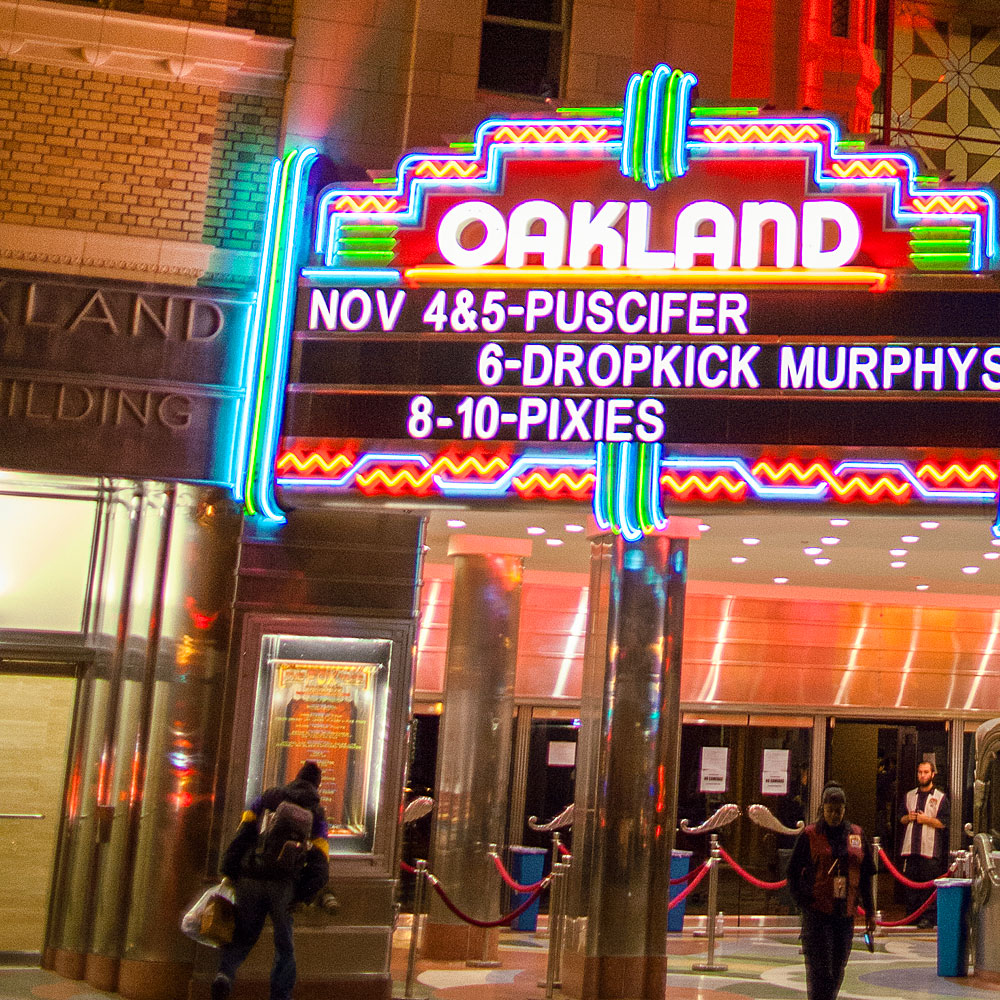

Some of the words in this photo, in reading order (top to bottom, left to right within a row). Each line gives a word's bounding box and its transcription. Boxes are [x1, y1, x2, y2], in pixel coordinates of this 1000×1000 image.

[436, 199, 862, 270] OAKLAND
[0, 283, 224, 342] LAND
[308, 288, 406, 332] NOV
[422, 289, 749, 335] 4&5-PUSCIFER
[477, 341, 760, 389] 6-DROPKICK
[406, 395, 666, 443] 8-10-PIXIES
